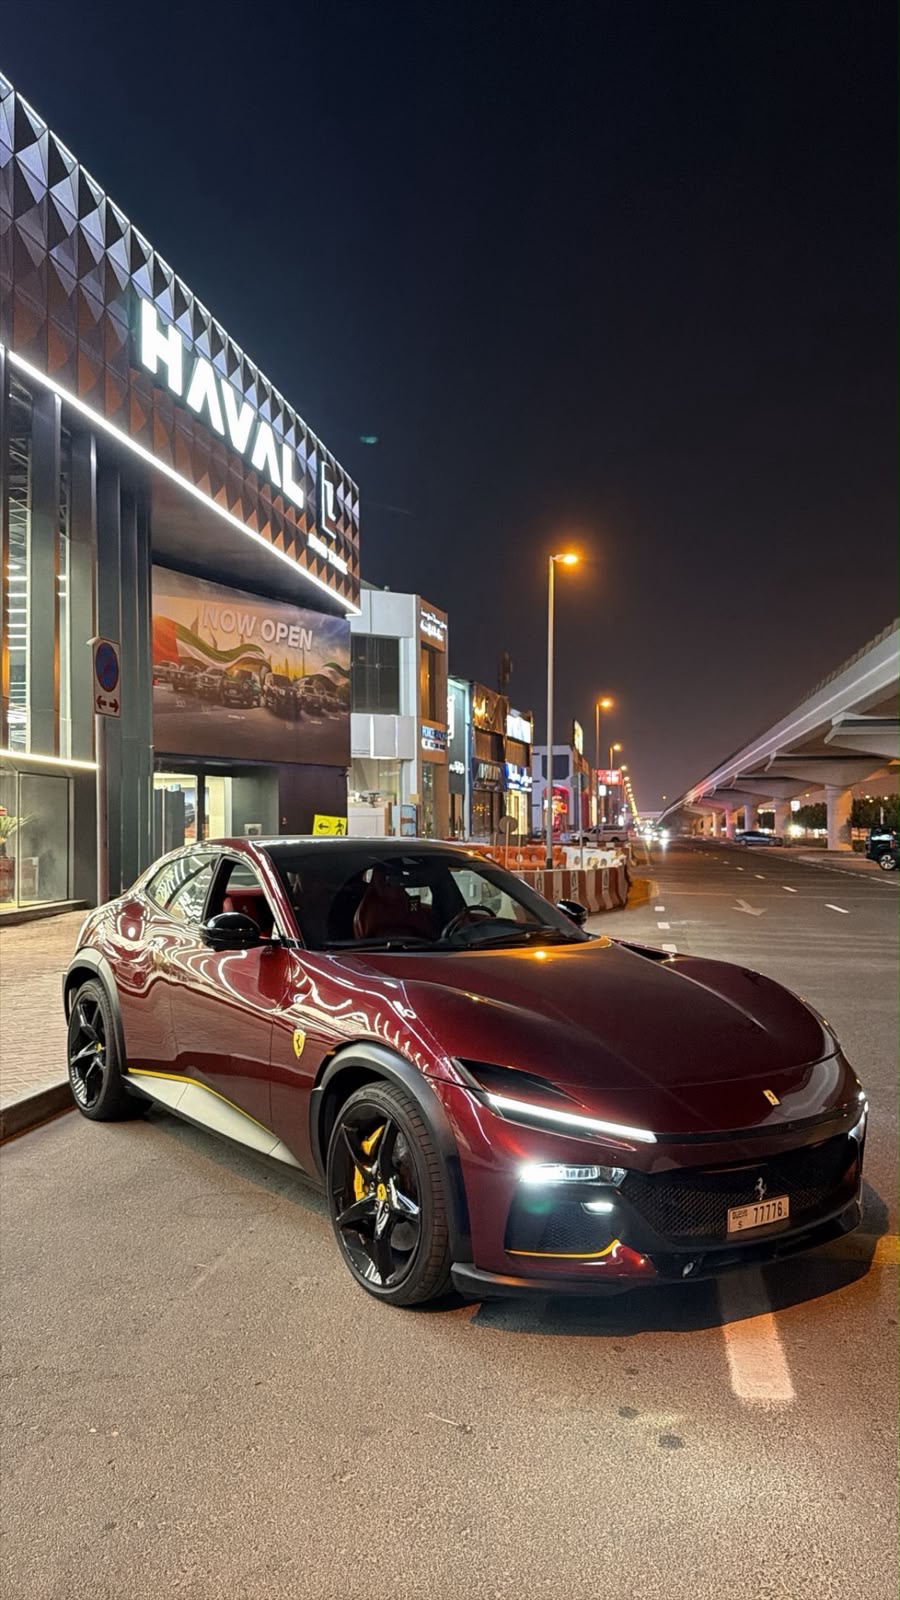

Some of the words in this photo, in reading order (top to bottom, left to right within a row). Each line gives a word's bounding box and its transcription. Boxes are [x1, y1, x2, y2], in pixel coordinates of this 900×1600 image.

[141, 297, 304, 508] HAVAL
[203, 605, 256, 637] NOW
[260, 619, 313, 650] OPEN
[753, 1201, 783, 1224] 77776
